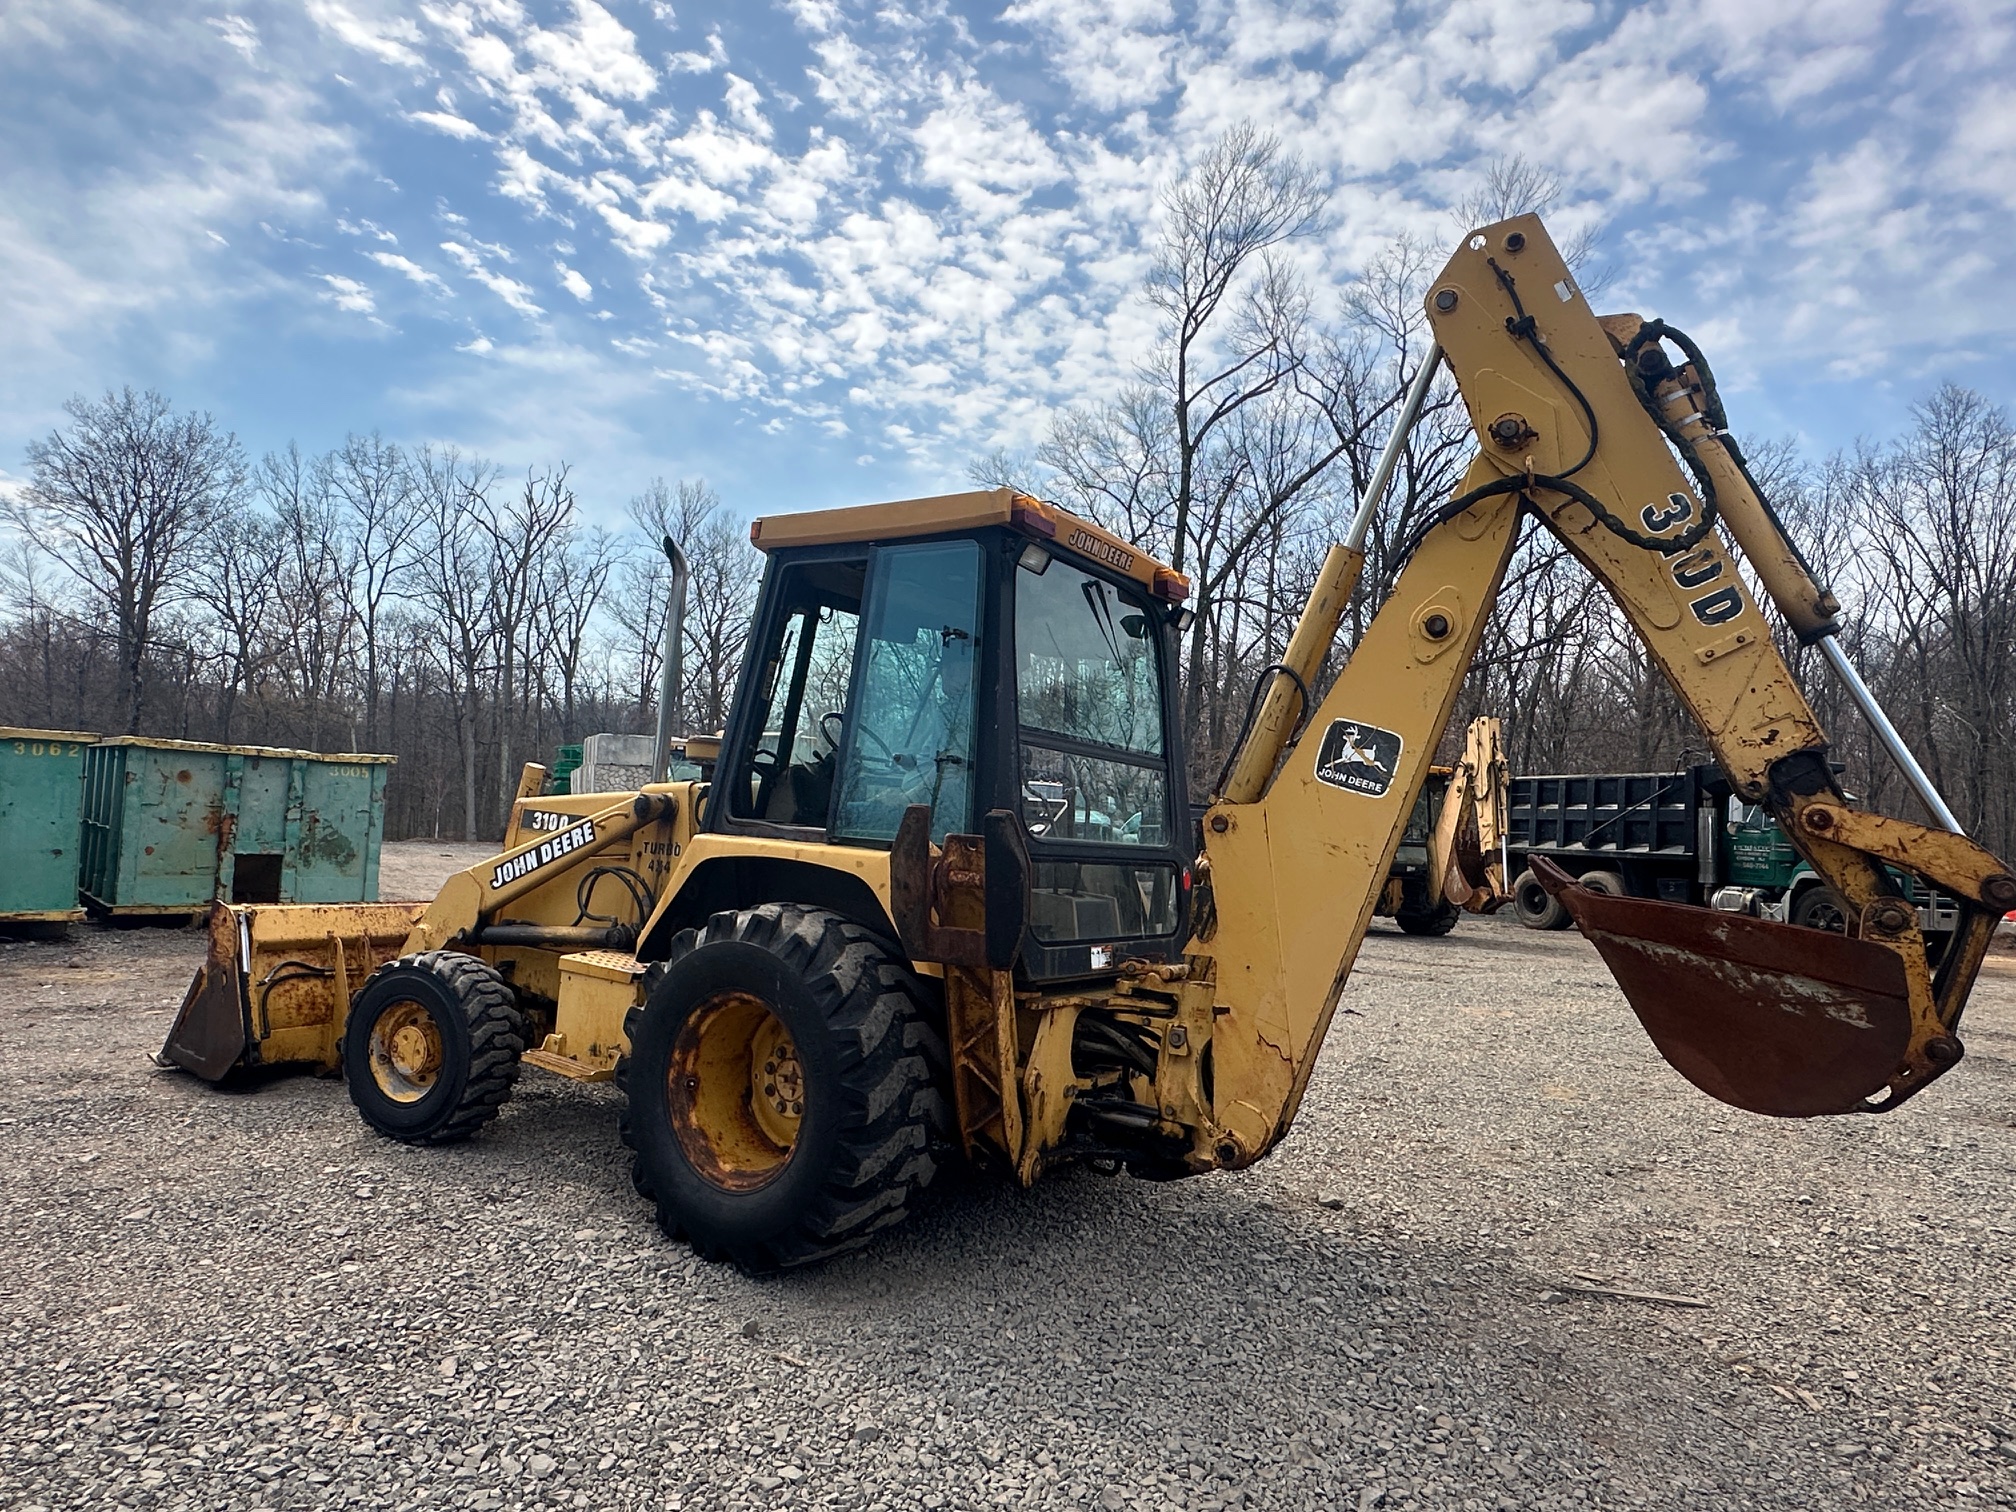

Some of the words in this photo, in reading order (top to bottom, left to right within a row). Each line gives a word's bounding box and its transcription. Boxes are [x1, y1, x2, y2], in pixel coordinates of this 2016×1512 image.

[1068, 529, 1102, 556] JOHN
[1099, 543, 1134, 571] DEERE
[14, 741, 80, 757] 3062
[329, 766, 370, 779] 3005
[1318, 768, 1347, 782] JOHN
[1348, 776, 1383, 792] DEERE
[491, 849, 538, 888] JOHN
[540, 821, 595, 863] DEERE
[643, 841, 681, 857] TURBO
